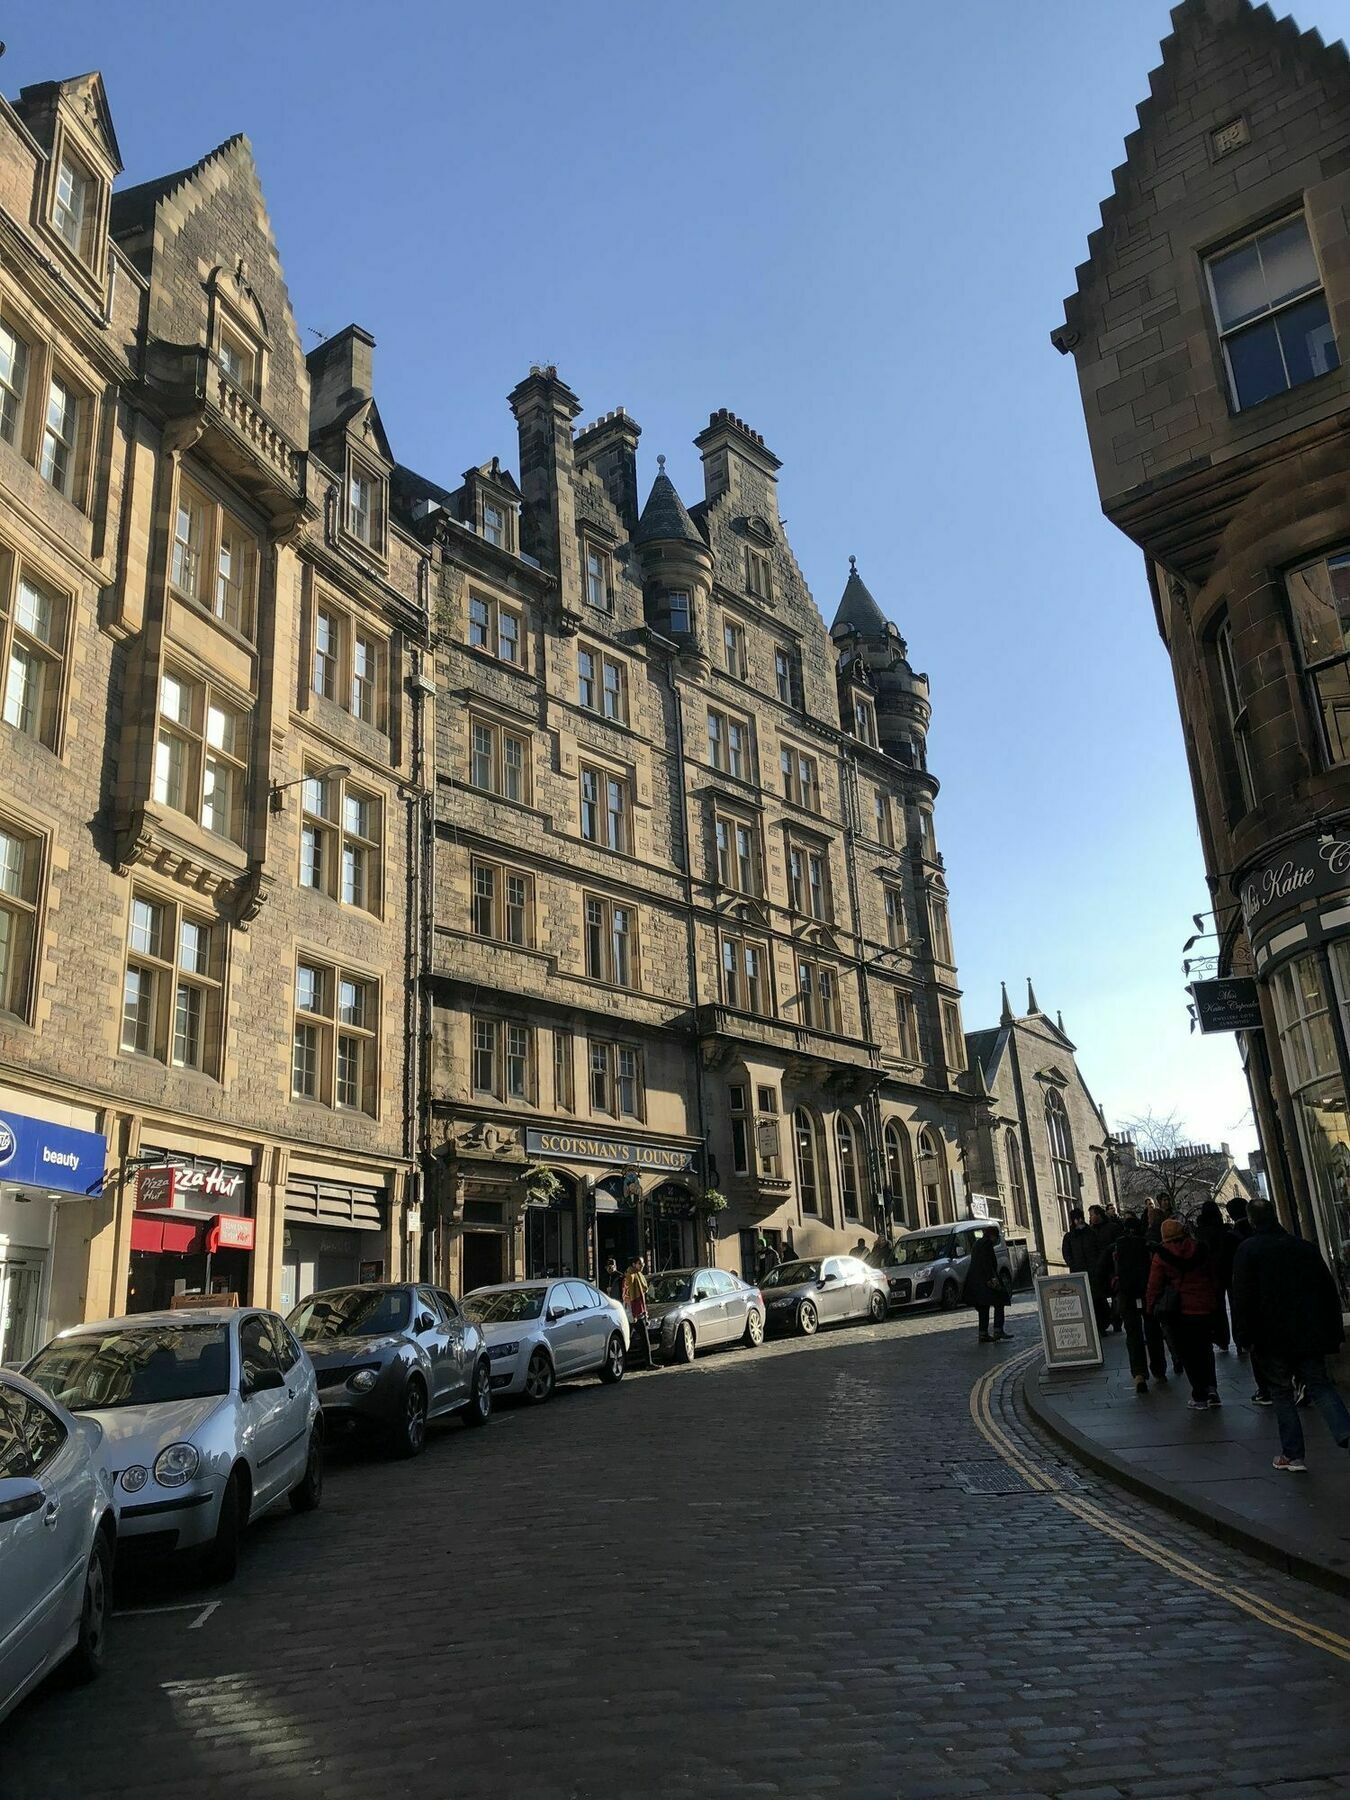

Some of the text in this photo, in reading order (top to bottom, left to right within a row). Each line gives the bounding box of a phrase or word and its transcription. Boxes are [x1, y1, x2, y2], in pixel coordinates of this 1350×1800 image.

[1262, 861, 1315, 906] Katie
[43, 1146, 79, 1171] beauty
[541, 1135, 687, 1168] SCOTSMAN'S LOUNGE
[141, 1177, 170, 1189] Pizza
[142, 1190, 164, 1201] Hut
[205, 1167, 244, 1197] Hut
